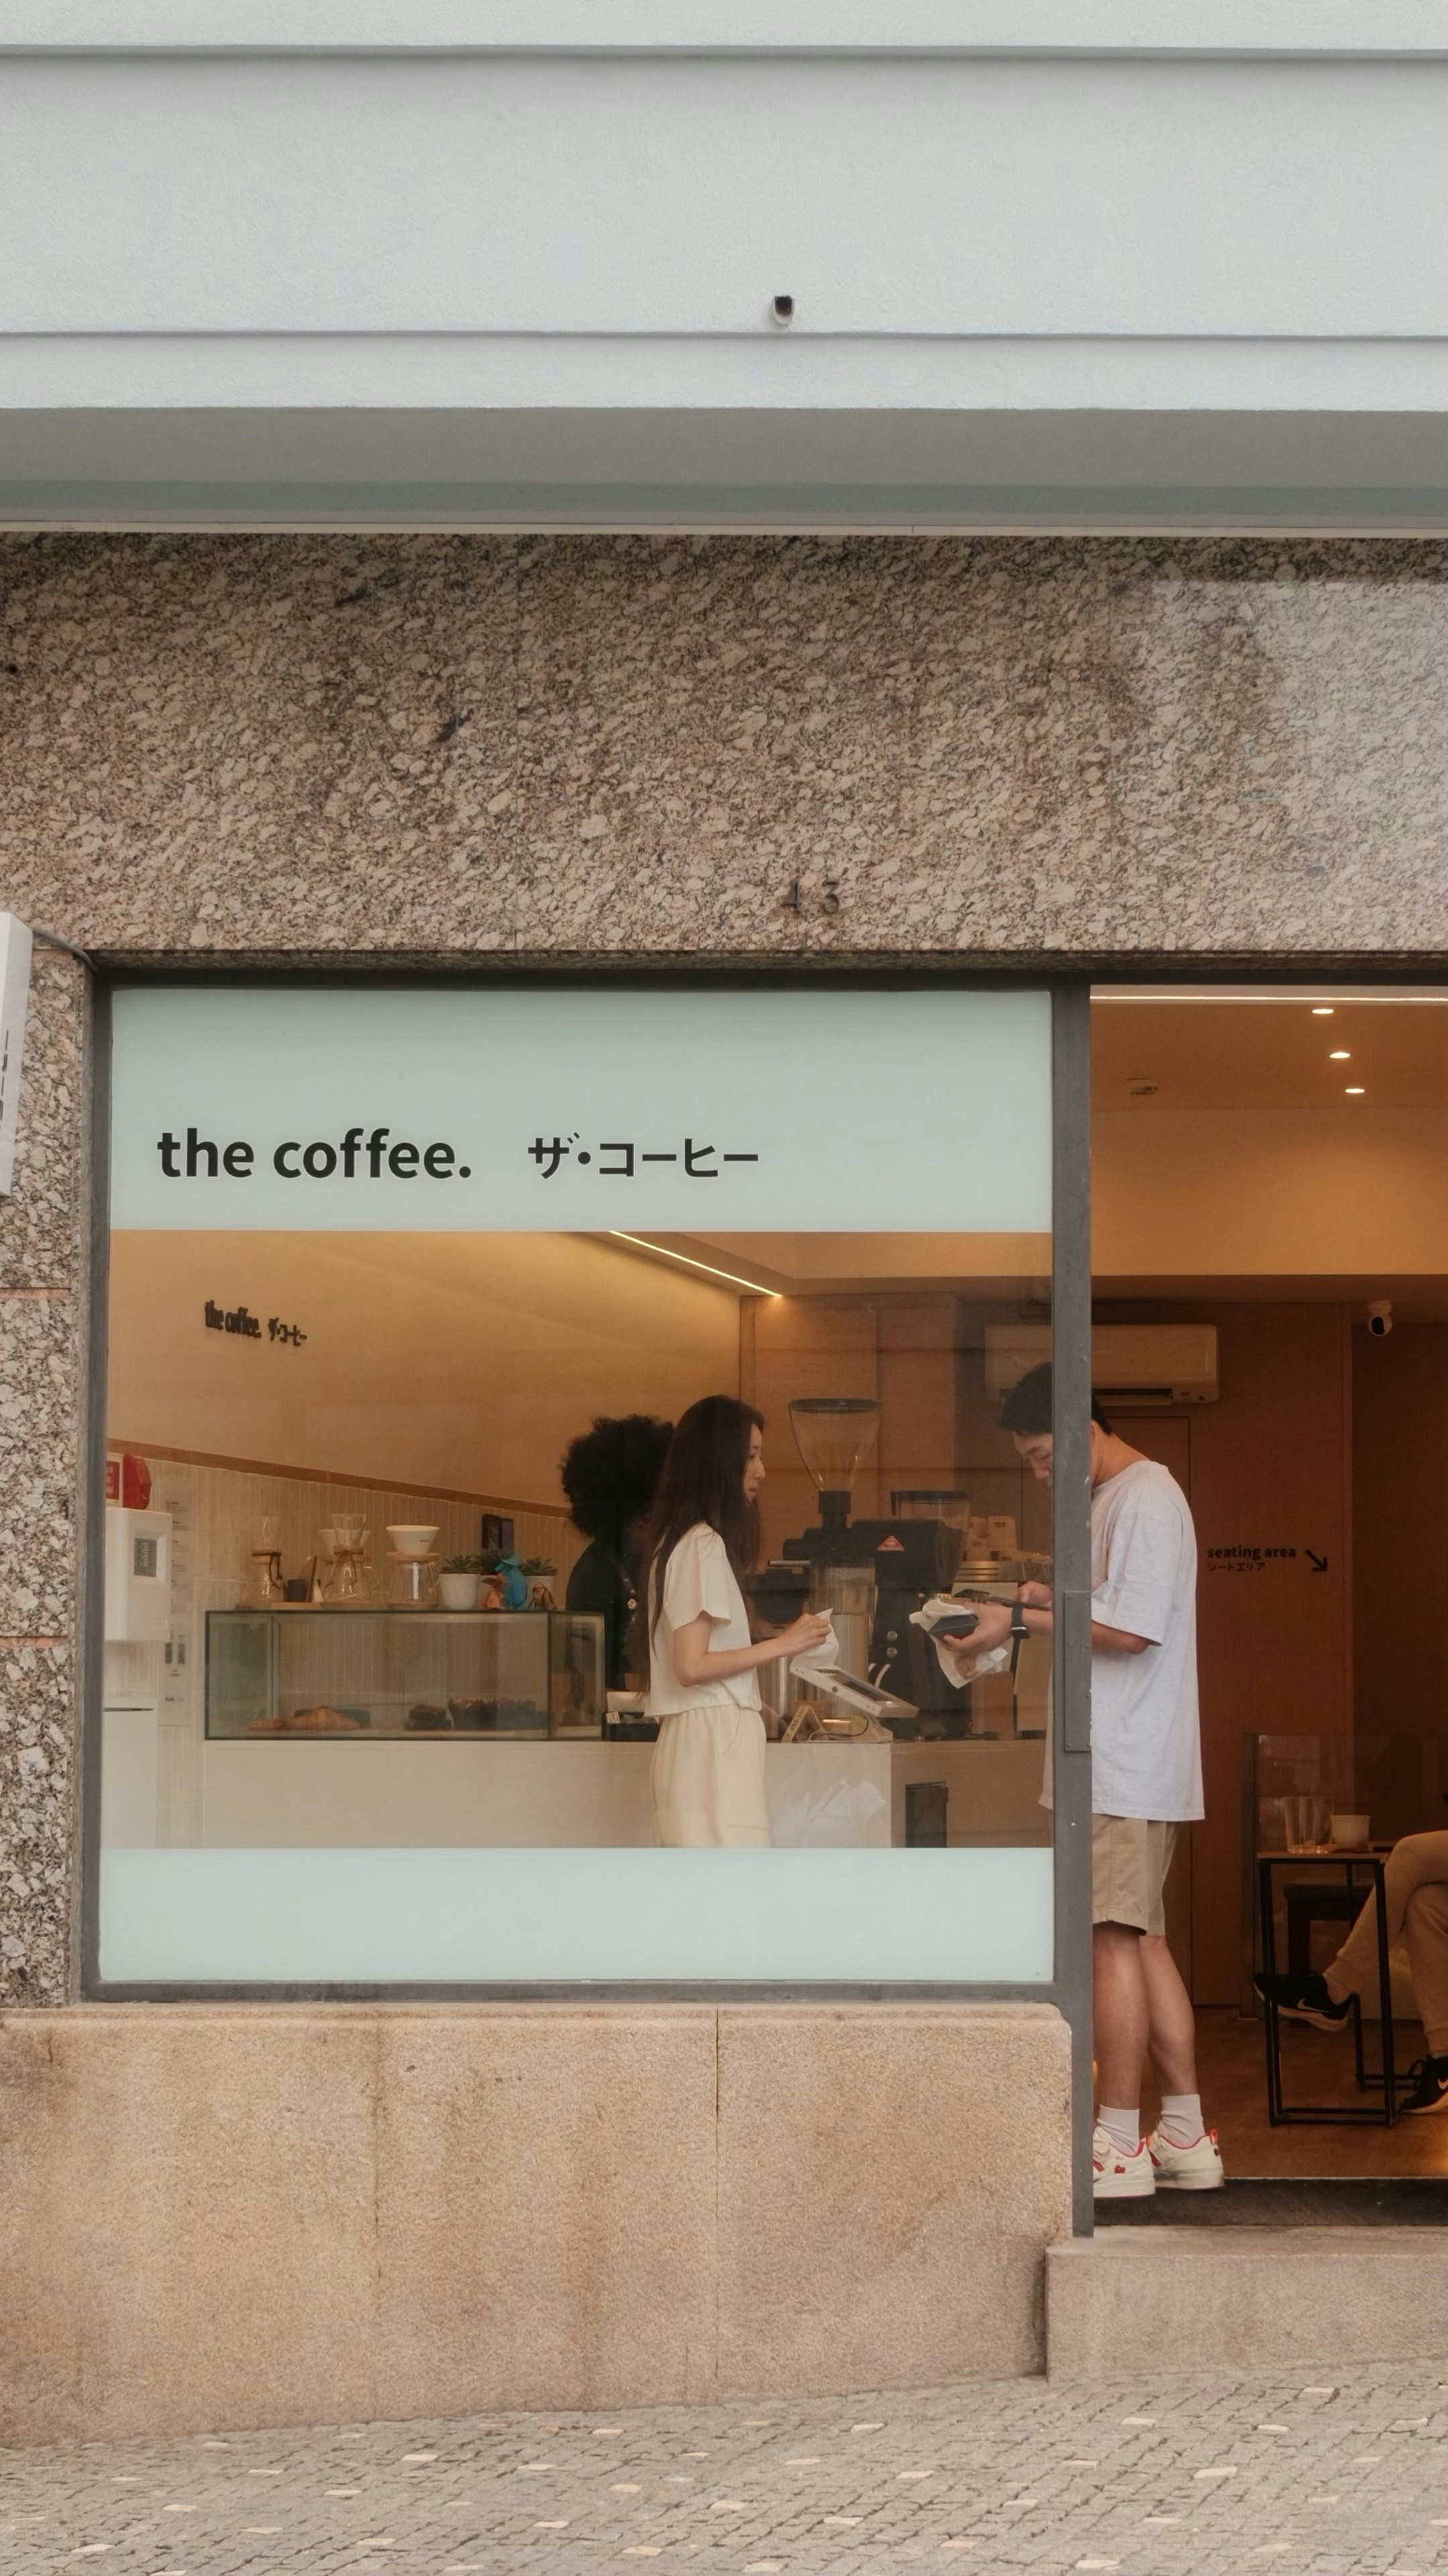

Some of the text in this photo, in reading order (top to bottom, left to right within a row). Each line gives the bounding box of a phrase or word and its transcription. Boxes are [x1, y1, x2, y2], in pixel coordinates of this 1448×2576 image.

[157, 1128, 472, 1179] the coffee.
[527, 1132, 759, 1179] ザ・コーヒー
[1207, 1545, 1296, 1561] seating area
